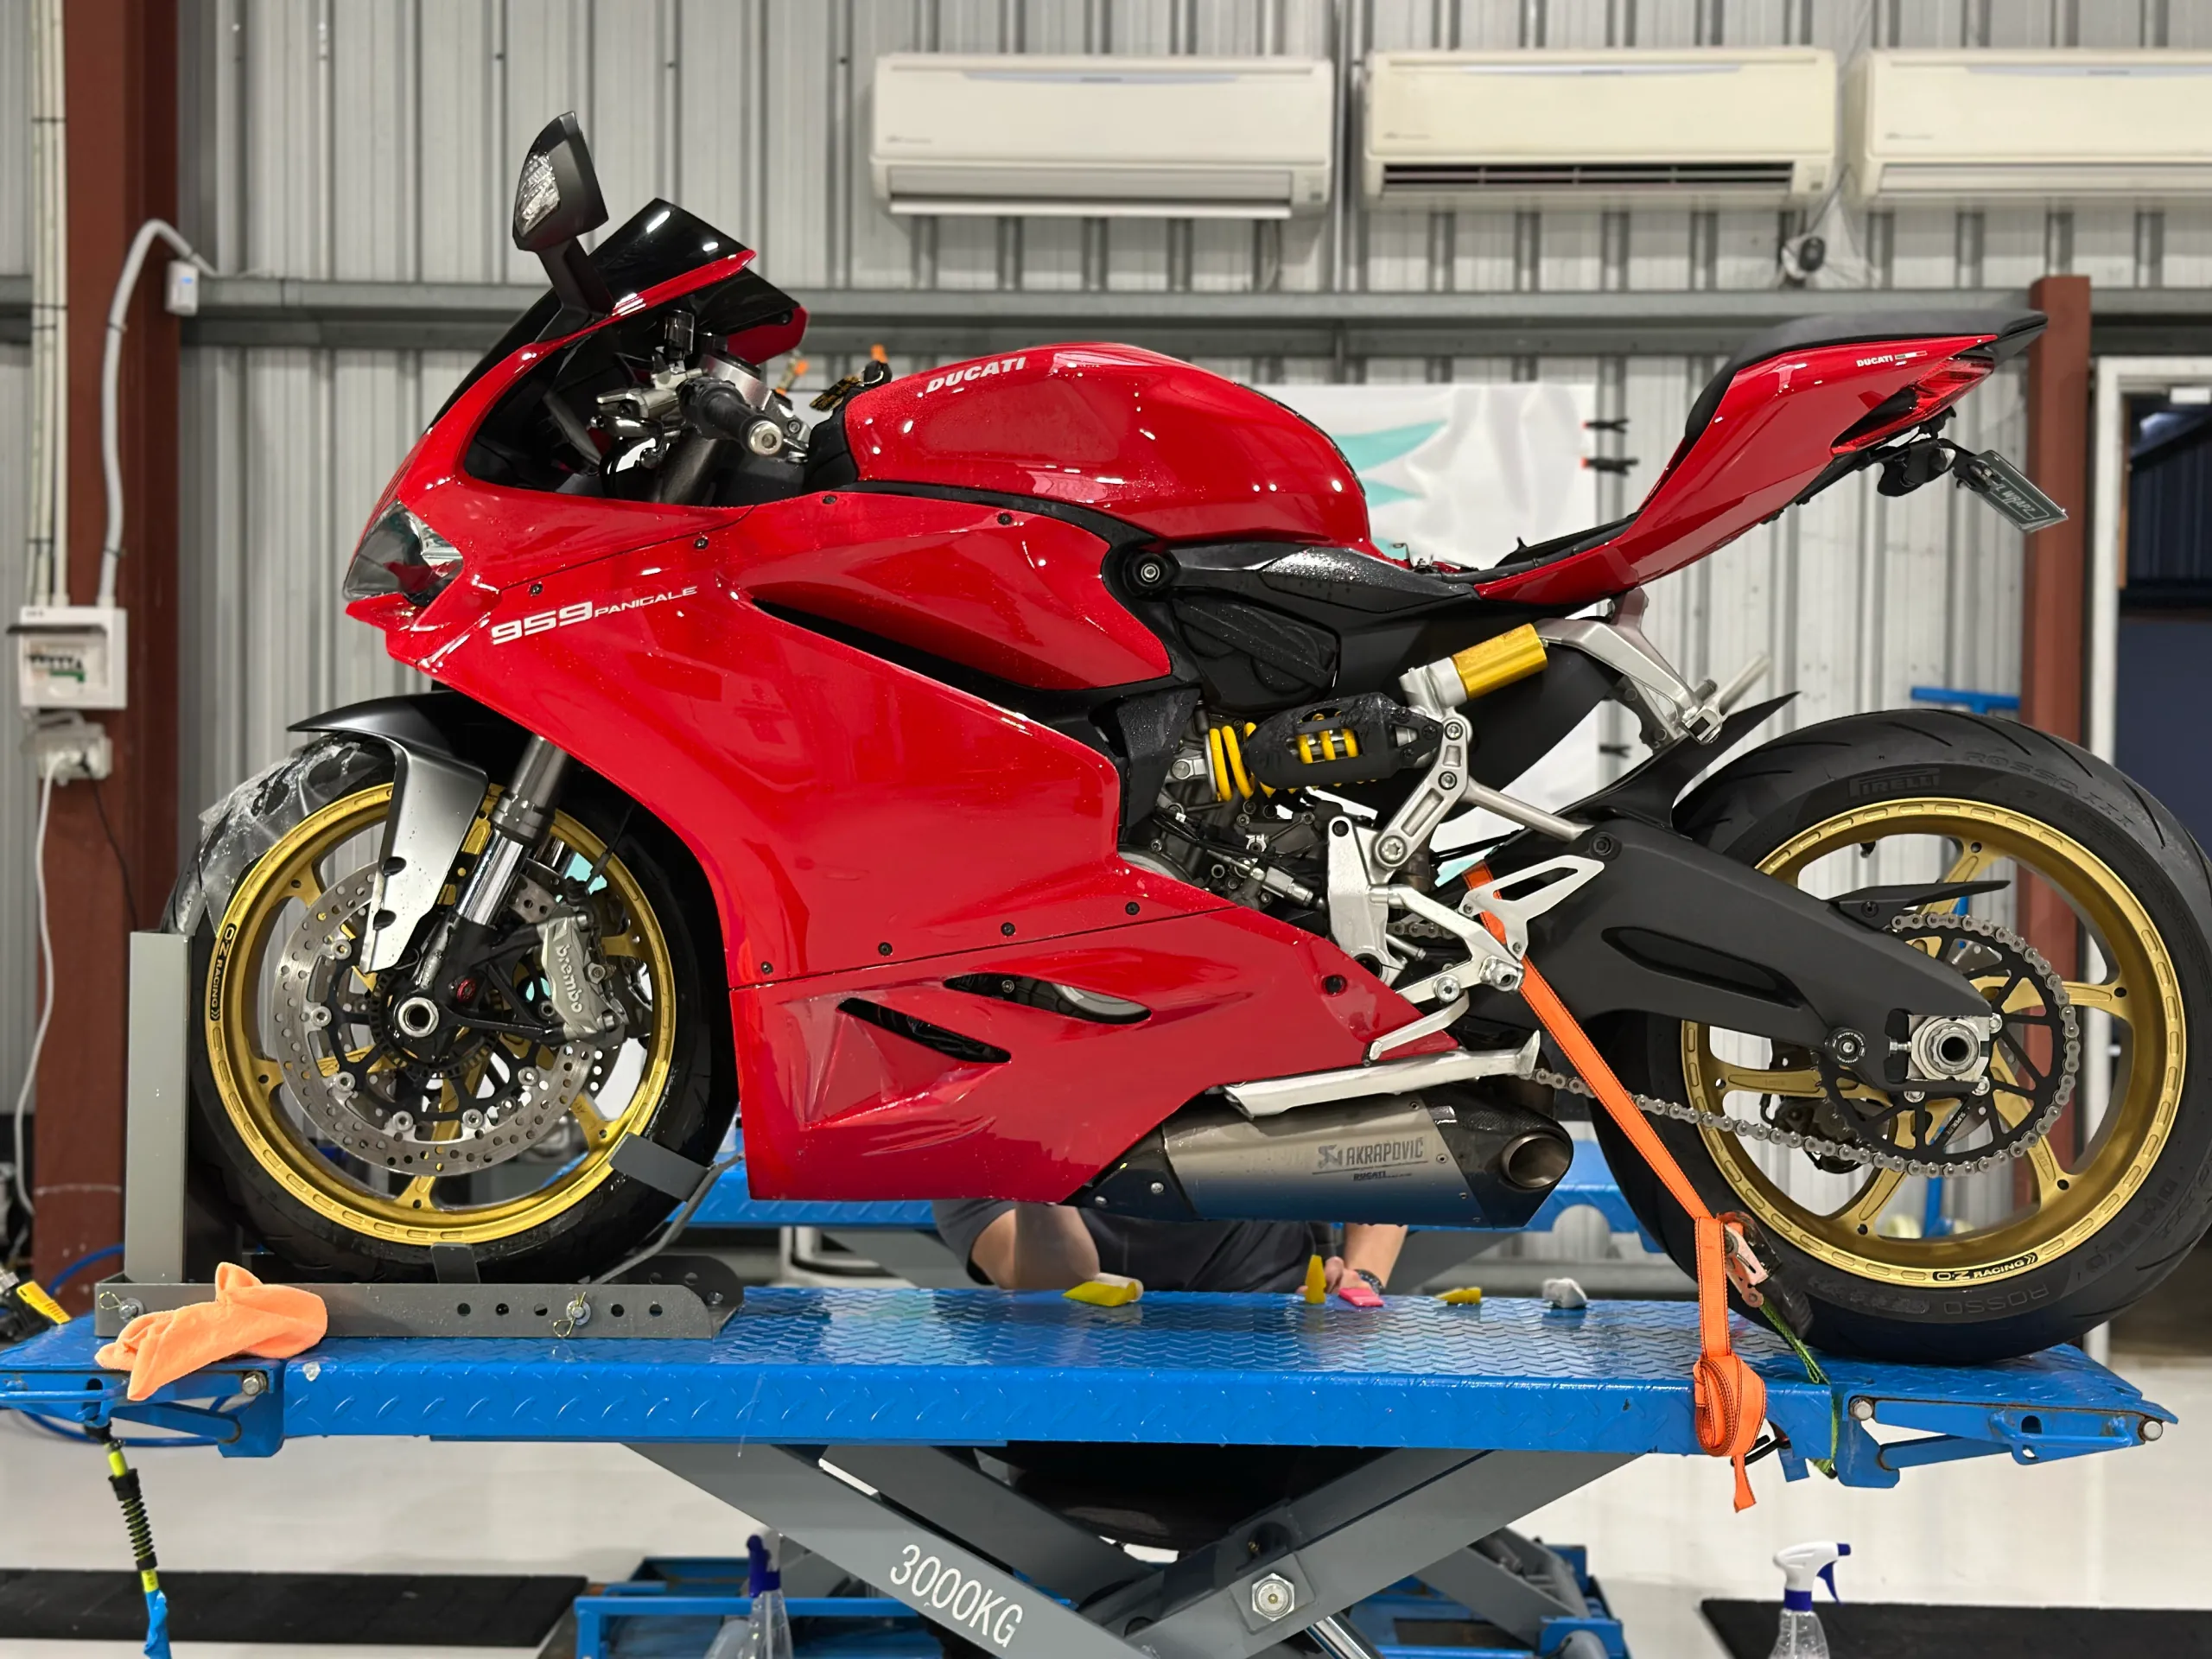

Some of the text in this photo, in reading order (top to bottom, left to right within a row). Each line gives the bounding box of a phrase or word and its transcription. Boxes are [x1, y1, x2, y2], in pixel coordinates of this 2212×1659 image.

[925, 357, 1027, 393] DUCATI
[1856, 355, 1894, 367] DUCATI
[491, 585, 698, 645] 959 PANIGALE
[1848, 767, 1940, 798] PIRELLI
[1966, 751, 2080, 798] ROSSO
[211, 958, 224, 1007] RACING
[556, 944, 582, 1013] brembo
[1973, 1259, 2025, 1280] RACING
[1943, 1283, 2050, 1315] ROSSO
[890, 1544, 1023, 1648] 3000KG
